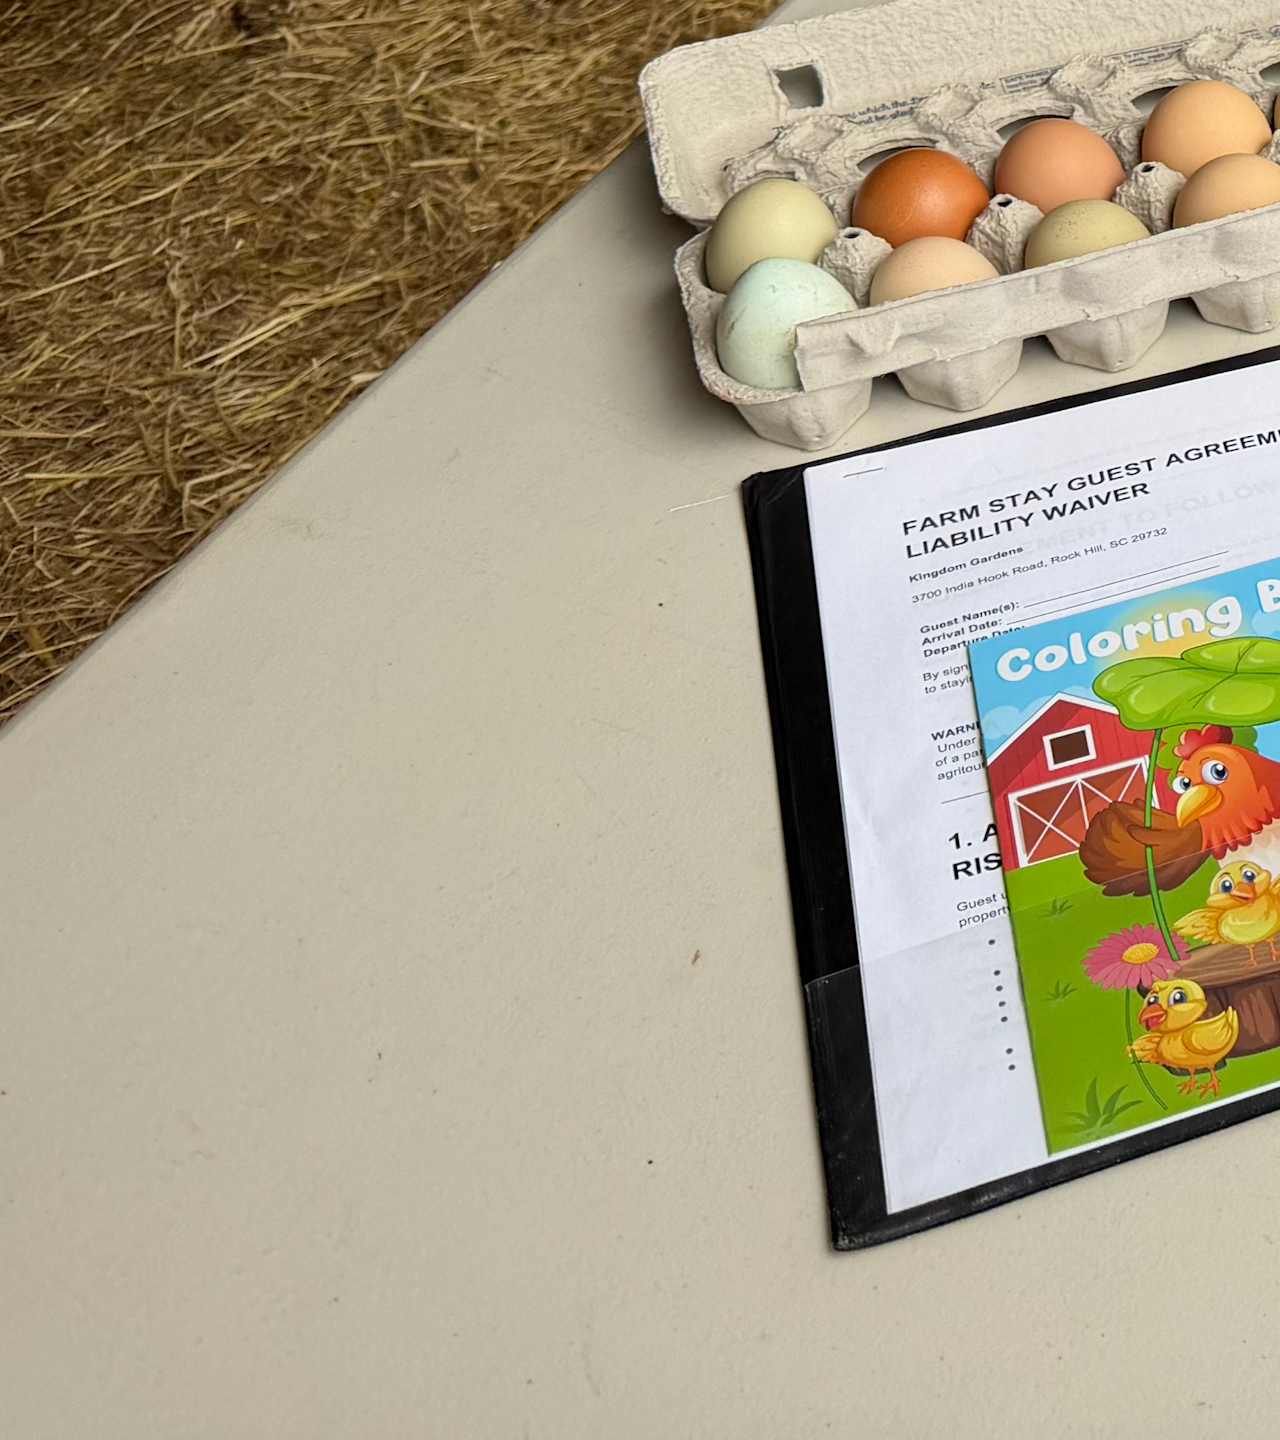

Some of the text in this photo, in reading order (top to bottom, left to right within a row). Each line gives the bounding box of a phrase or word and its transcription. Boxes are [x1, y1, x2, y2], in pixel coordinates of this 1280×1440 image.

[903, 504, 981, 537] FARM
[989, 482, 1059, 514] STAY
[1067, 457, 1157, 492] GUEST
[906, 481, 1151, 559] LIABILITY WAIVER
[909, 545, 1025, 584] Kingdom Gardens
[912, 588, 942, 603] 3700
[945, 580, 974, 595] India
[977, 570, 1010, 587] Hook
[1012, 559, 1048, 577] Road,
[1050, 549, 1081, 565] Rock
[1109, 536, 1128, 550] SC
[1131, 526, 1168, 543] 29732
[920, 601, 1020, 634] Guest Name(s):
[921, 618, 1002, 646] Arrival Date:
[994, 595, 1244, 683] Coloring
[922, 671, 940, 683] By
[924, 685, 937, 695] to
[937, 736, 976, 753] Under
[935, 755, 949, 768] of
[951, 754, 960, 763] a
[948, 831, 973, 851] 1.
[956, 892, 999, 913] Guest
